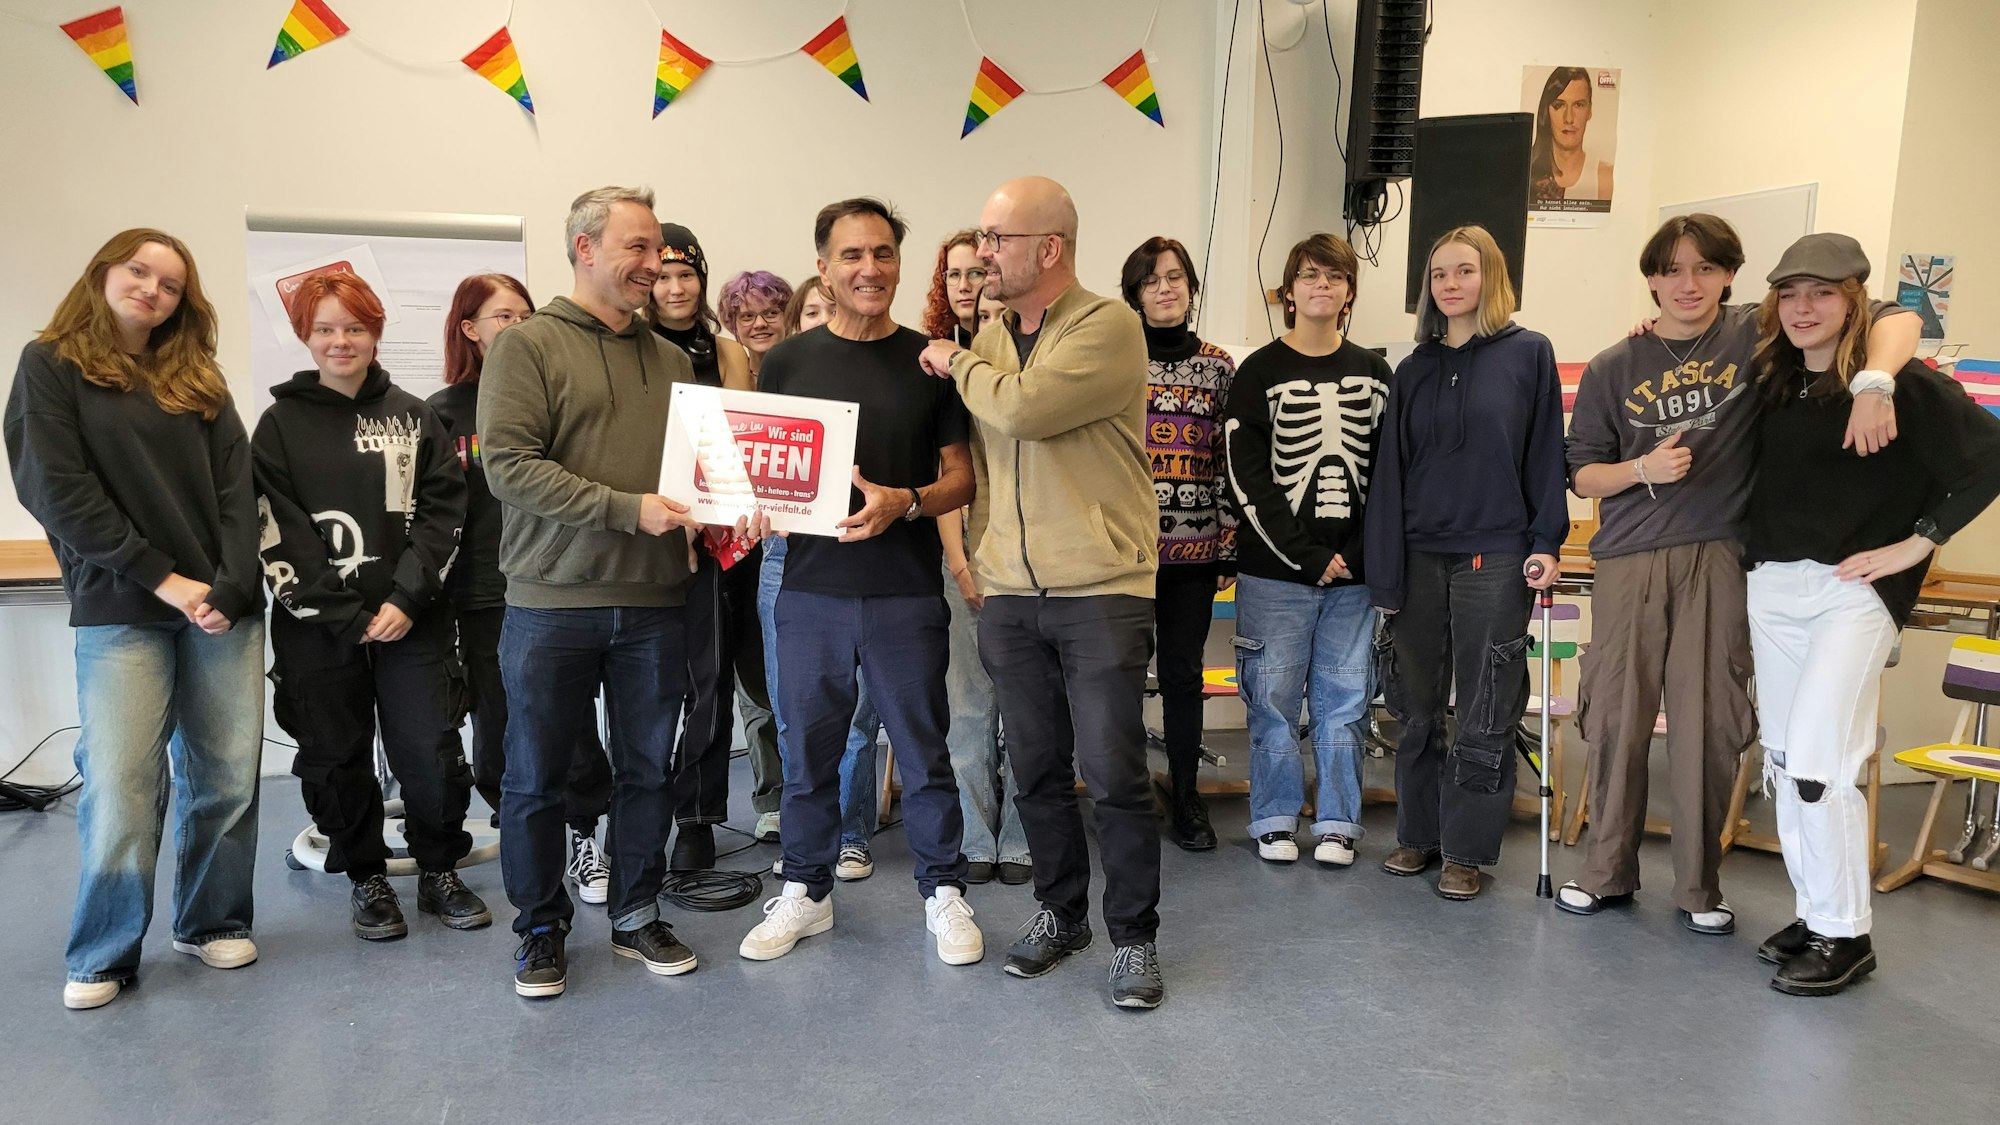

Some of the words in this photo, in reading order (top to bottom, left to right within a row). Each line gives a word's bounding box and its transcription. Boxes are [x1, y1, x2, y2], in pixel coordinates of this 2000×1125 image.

[1624, 360, 1738, 415] ITASCA
[1655, 386, 1714, 421] 1891
[768, 426, 787, 440] Wir
[790, 428, 814, 443] sind
[737, 440, 813, 482] FFEN
[757, 485, 764, 493] bi
[768, 486, 789, 496] hetero
